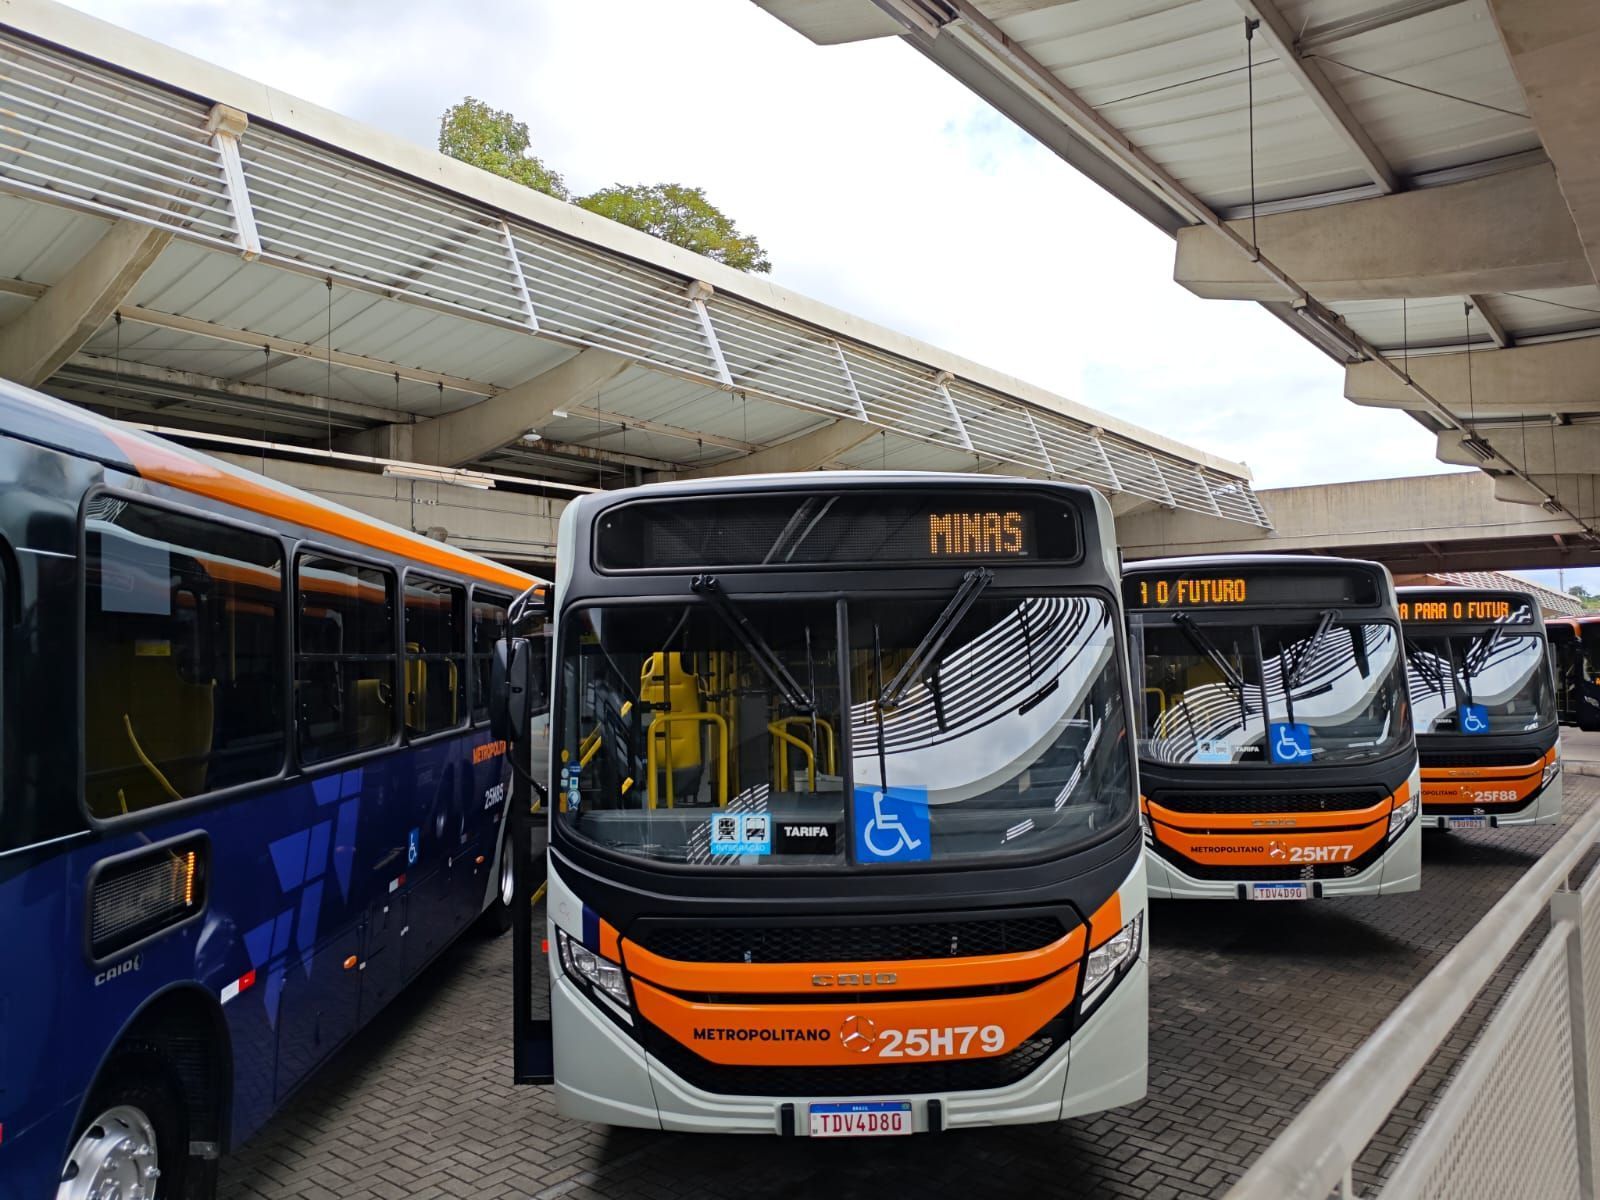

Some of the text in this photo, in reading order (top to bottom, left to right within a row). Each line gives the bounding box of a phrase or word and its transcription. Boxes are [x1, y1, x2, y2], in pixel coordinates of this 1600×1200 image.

[930, 512, 1022, 554] MINAS
[1178, 579, 1246, 603] FUTURO
[1414, 602, 1447, 619] PARA
[1468, 601, 1509, 619] FUTUR
[1474, 790, 1517, 802] 25F88
[784, 826, 829, 837] TARIFA
[1290, 845, 1353, 862] 25H77
[693, 1027, 831, 1042] METROPOLITANO
[879, 1024, 1006, 1057] 25H79
[820, 1112, 902, 1133] TDV4D80
